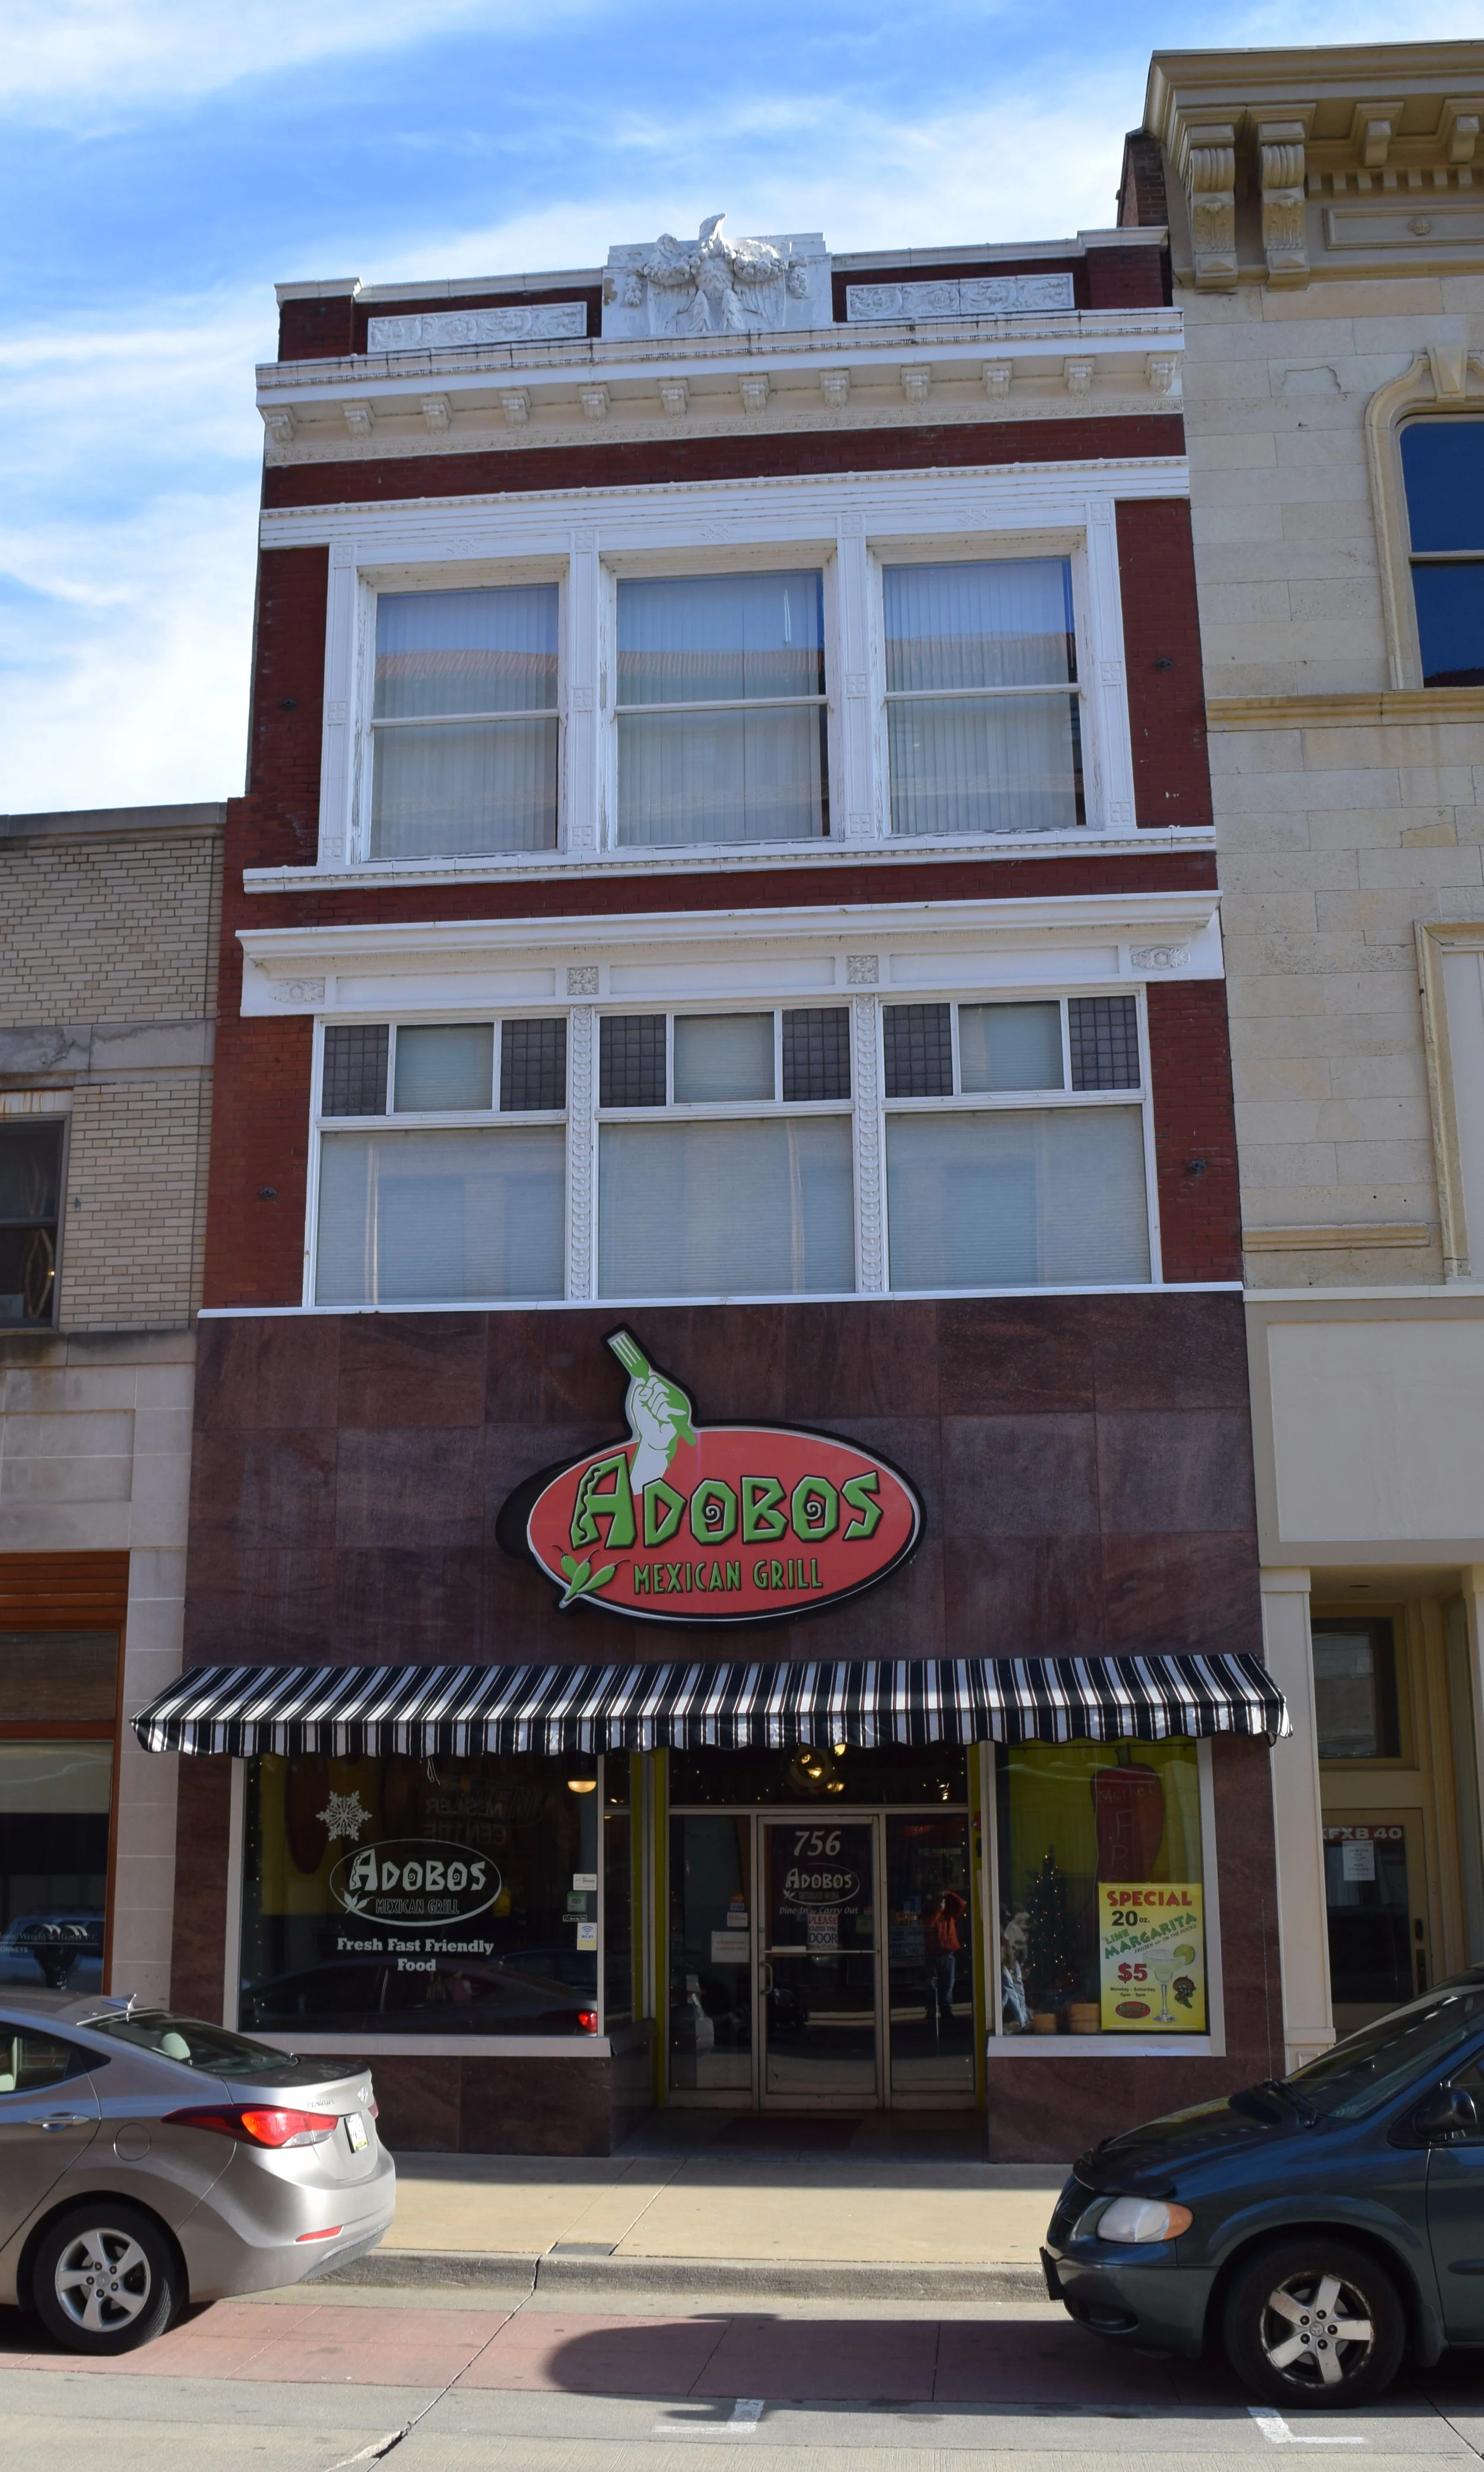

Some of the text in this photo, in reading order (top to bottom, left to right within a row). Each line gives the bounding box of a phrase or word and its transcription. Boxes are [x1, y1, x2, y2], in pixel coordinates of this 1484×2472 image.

[570, 1452, 884, 1550] ADOBOS
[633, 1558, 823, 1595] MEXICAN GRILL
[1374, 1827, 1403, 1840] 40
[794, 1830, 842, 1857] 756
[349, 1847, 487, 1891] ADOBOS
[785, 1868, 852, 1889] ADOBOS
[375, 1898, 459, 1915] MEXICAN GRILL
[1106, 1890, 1193, 1907] SPECIAL
[779, 1906, 797, 1915] Dine
[800, 1906, 809, 1915] In
[819, 1906, 842, 1916] Carry
[844, 1906, 859, 1915] Out
[1111, 1910, 1138, 1926] 20
[808, 1916, 837, 1925] PLEASE
[20, 1932, 46, 1941] Wright
[808, 1932, 837, 1944] DOOR
[1105, 1912, 1197, 1960] MARGARITA
[1105, 1928, 1130, 1945] LIME
[1134, 1942, 1153, 1954] FROZEN
[1180, 1924, 1197, 1935] ROCKS
[337, 1938, 494, 1956] Fresh Fast Friendly
[397, 1958, 436, 1972] Food
[1118, 1963, 1147, 1983] $5
